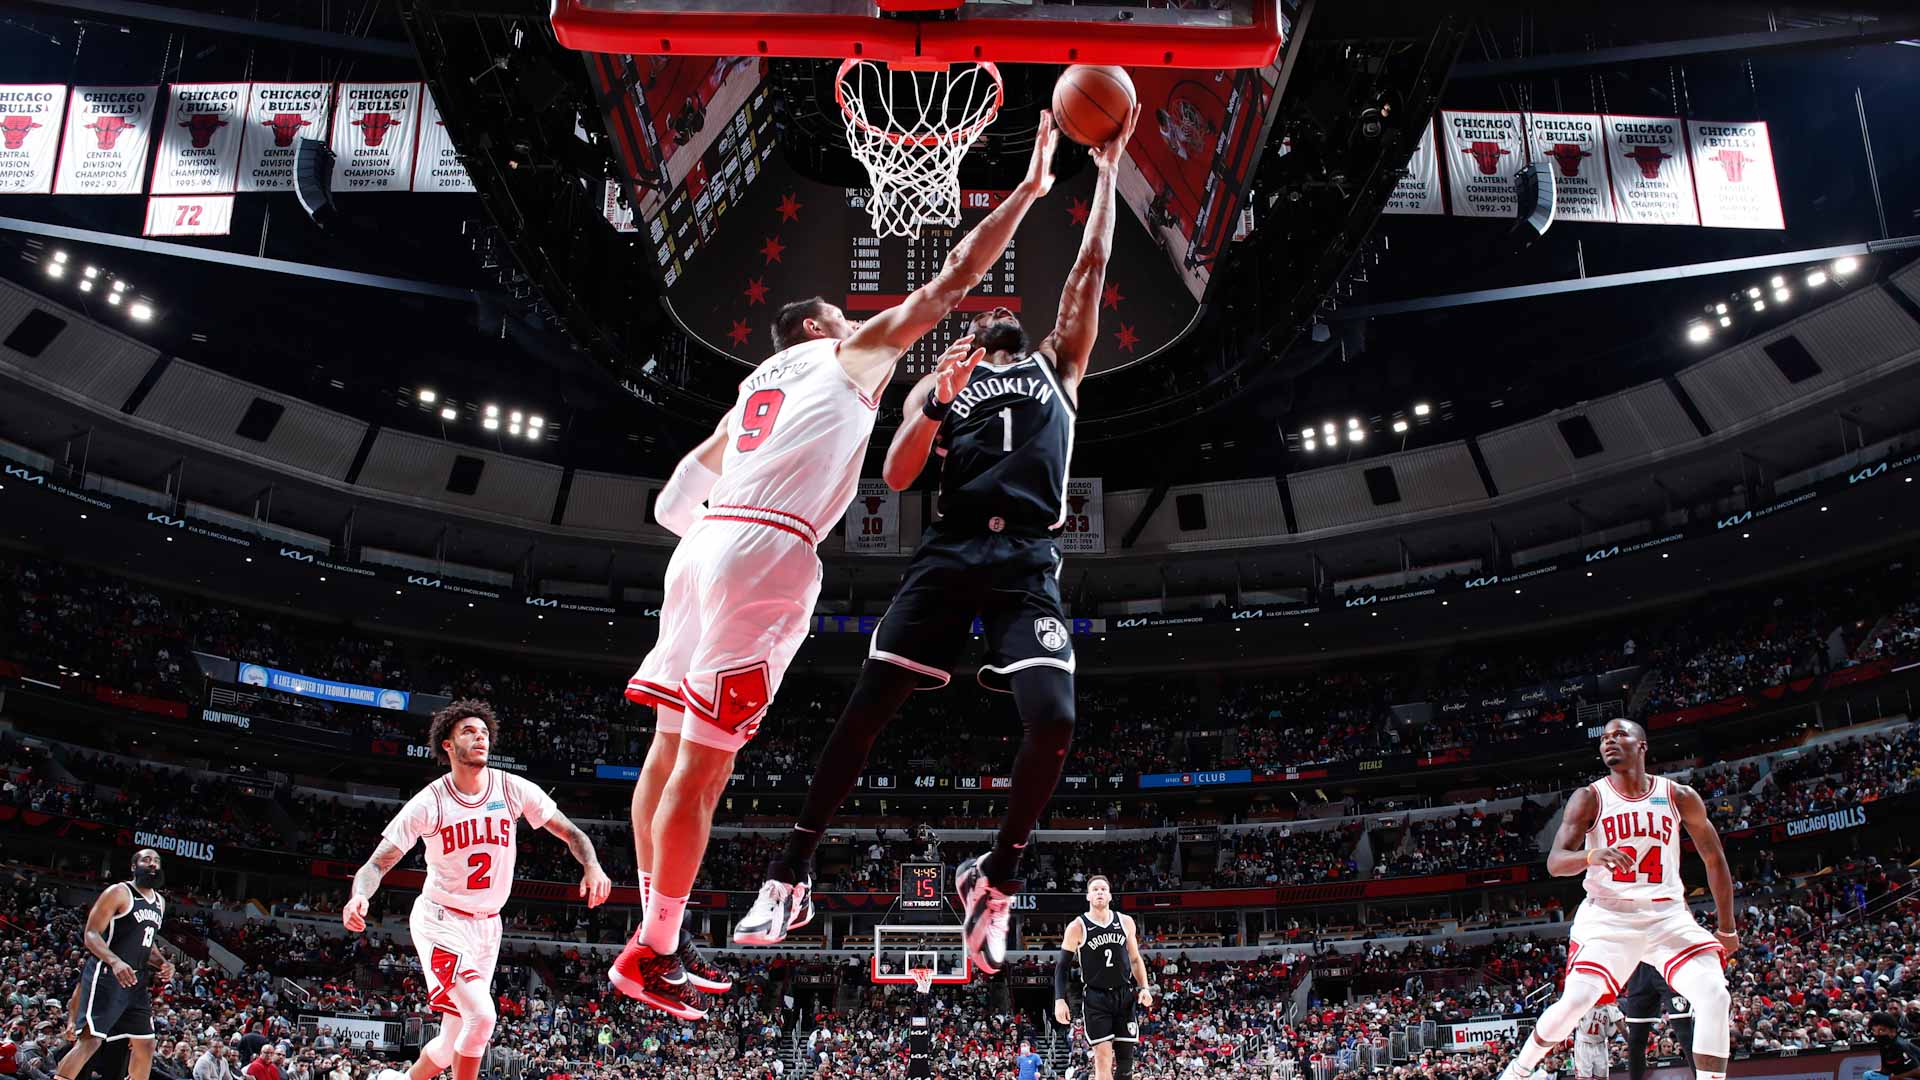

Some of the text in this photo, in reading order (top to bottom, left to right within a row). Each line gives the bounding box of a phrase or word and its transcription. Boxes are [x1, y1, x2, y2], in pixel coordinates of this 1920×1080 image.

[0, 92, 52, 102] HICAGO
[84, 92, 145, 102] CHICAGO
[179, 91, 238, 100] CHICAGO
[260, 90, 320, 99] CHICAGO
[350, 90, 408, 100] CHICAGO
[0, 104, 42, 112] BULLS
[92, 104, 134, 114] BULLS
[187, 102, 228, 112] BULLS
[268, 102, 310, 111] BULLS
[357, 102, 400, 110] BULLS
[1454, 118, 1512, 128] CHICAGO
[1535, 120, 1592, 131] CHICAGO
[1615, 123, 1672, 134] CHICAGO
[1700, 126, 1756, 136] CHICAGO
[1464, 130, 1506, 140] BULLS
[1546, 132, 1586, 142] BULLS
[1626, 134, 1666, 144] BULLS
[1710, 138, 1750, 148] BULLS
[260, 158, 294, 166] DIVISIO
[252, 169, 292, 177] CHAMPIO
[439, 179, 474, 187] 2010-1
[1466, 185, 1516, 193] CONFERENCE
[968, 192, 990, 206] 102
[1628, 191, 1678, 200] CONFERENCE
[176, 205, 203, 226] 72
[858, 238, 880, 246] GRIFFIN
[858, 249, 879, 257] BROWN
[858, 260, 880, 268] HARDEN
[951, 377, 1053, 418] BROOKLYN
[737, 388, 786, 452] 9
[1000, 407, 1012, 452] 1
[862, 517, 882, 534] 10
[1066, 515, 1089, 532] 33
[274, 674, 278, 684] A
[279, 676, 291, 686] LIFE
[317, 682, 324, 694] TO
[325, 684, 349, 698] TEQUILA
[350, 688, 374, 702] MAKING
[203, 709, 250, 728] RUN WITH US
[406, 744, 430, 758] 9:07
[1359, 760, 1383, 770] STEALS
[878, 777, 888, 786] 88
[914, 776, 935, 787] 4:45
[962, 778, 976, 787] 102
[1198, 773, 1226, 782] CLUB
[1788, 806, 1866, 836] CHICAGO BULLS
[1602, 812, 1672, 846] BULLS
[440, 816, 510, 856] BULLS
[134, 831, 214, 862] CHICAGO BULLS
[1612, 846, 1663, 883] 24
[467, 852, 491, 889] 2
[913, 868, 937, 878] 4:45
[917, 879, 934, 898] 15
[1010, 895, 1037, 909] ULLS
[142, 926, 154, 948] 13
[1088, 933, 1126, 950] BROOKLYN
[1105, 949, 1113, 967] 2
[334, 1026, 380, 1040] Advocate
[1465, 1026, 1515, 1043] impact
